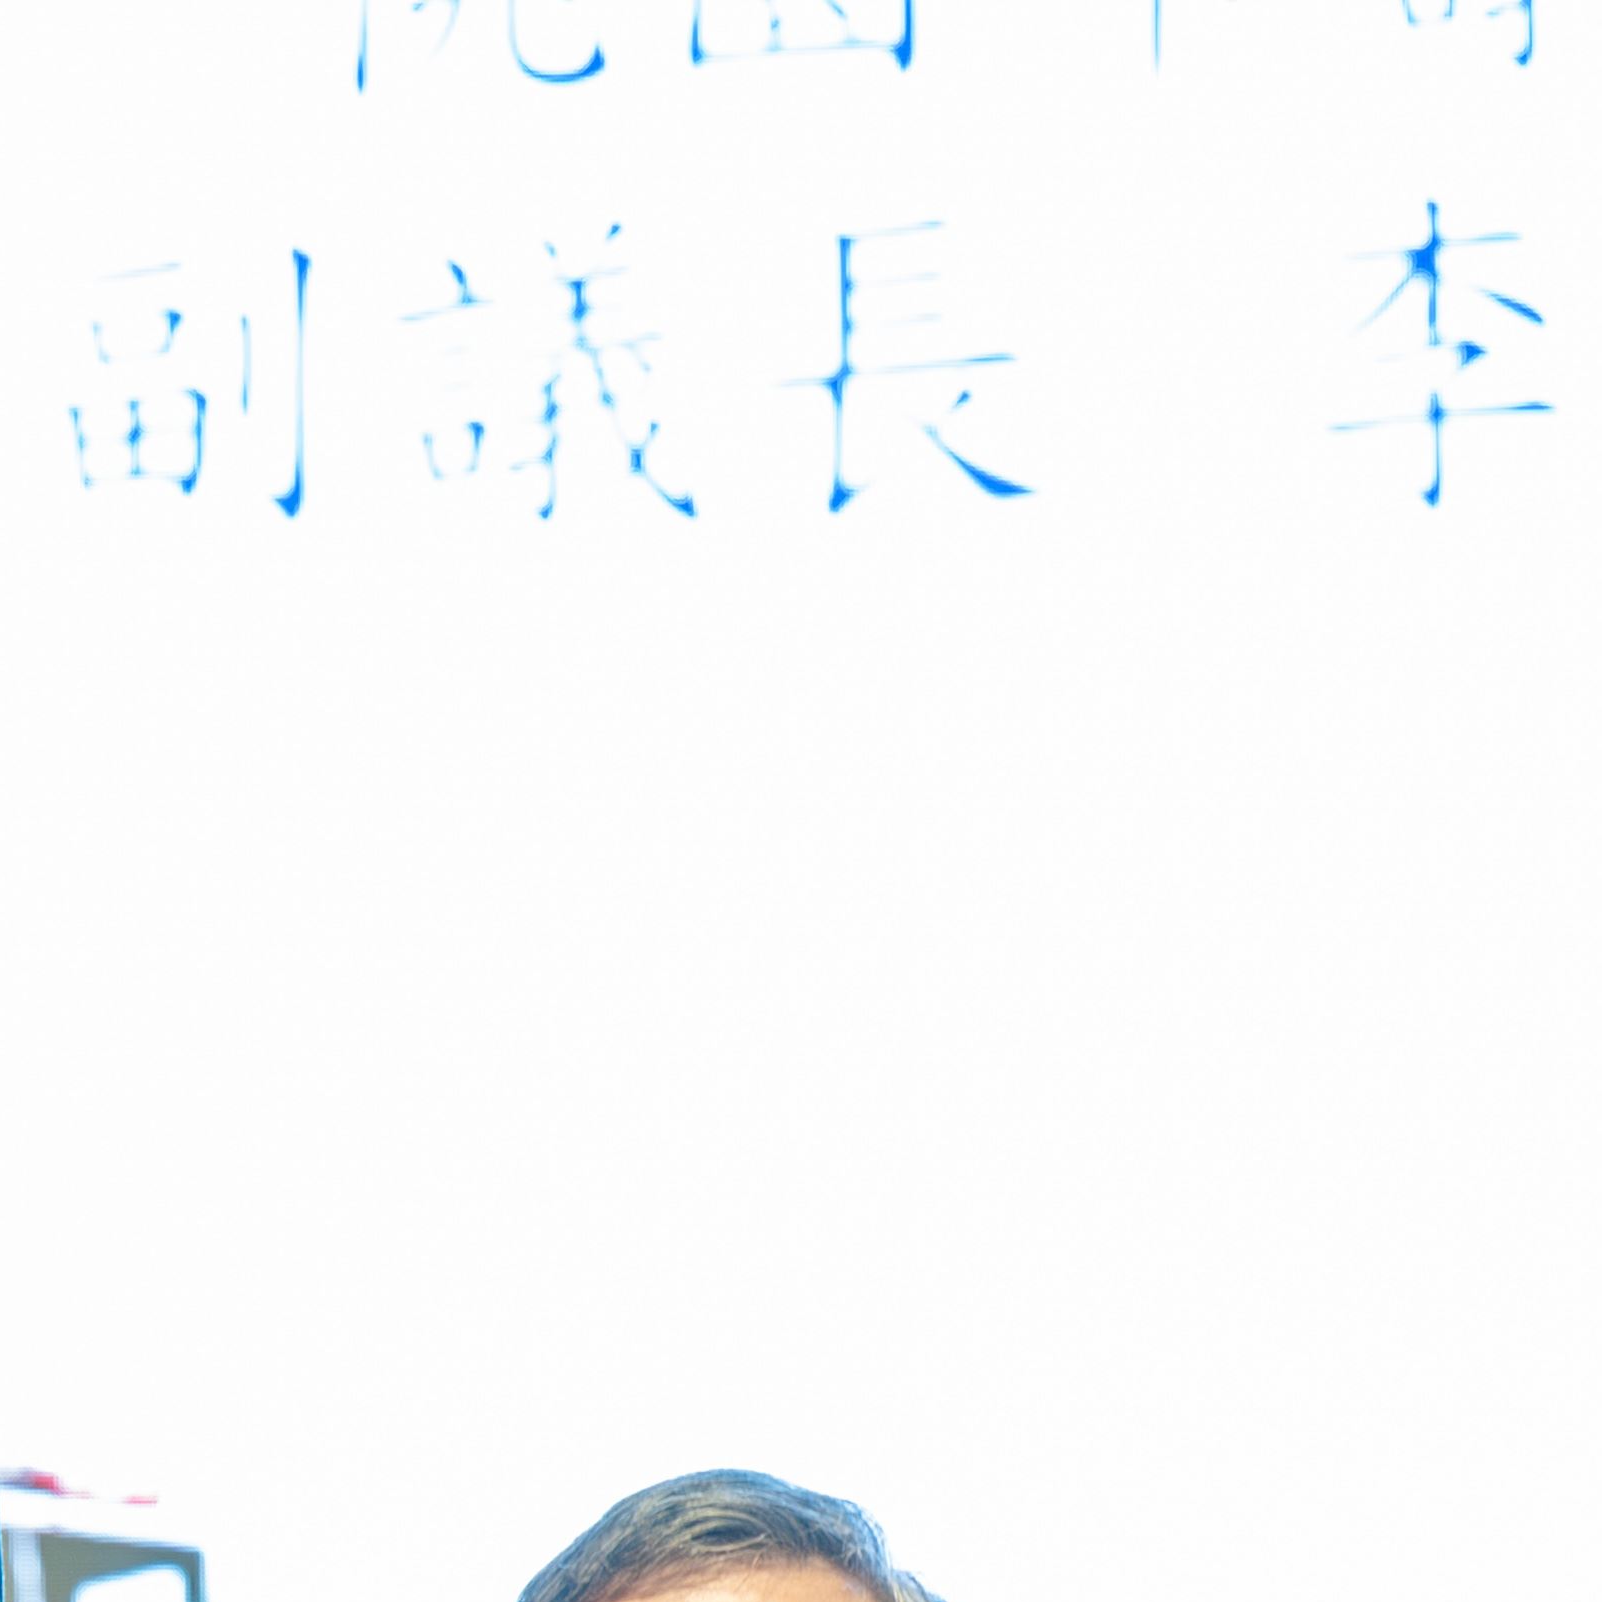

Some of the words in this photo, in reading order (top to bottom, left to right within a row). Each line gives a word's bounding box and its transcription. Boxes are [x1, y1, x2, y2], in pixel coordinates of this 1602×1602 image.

[68, 220, 1037, 518] 副議長
[1327, 200, 1557, 508] 李
